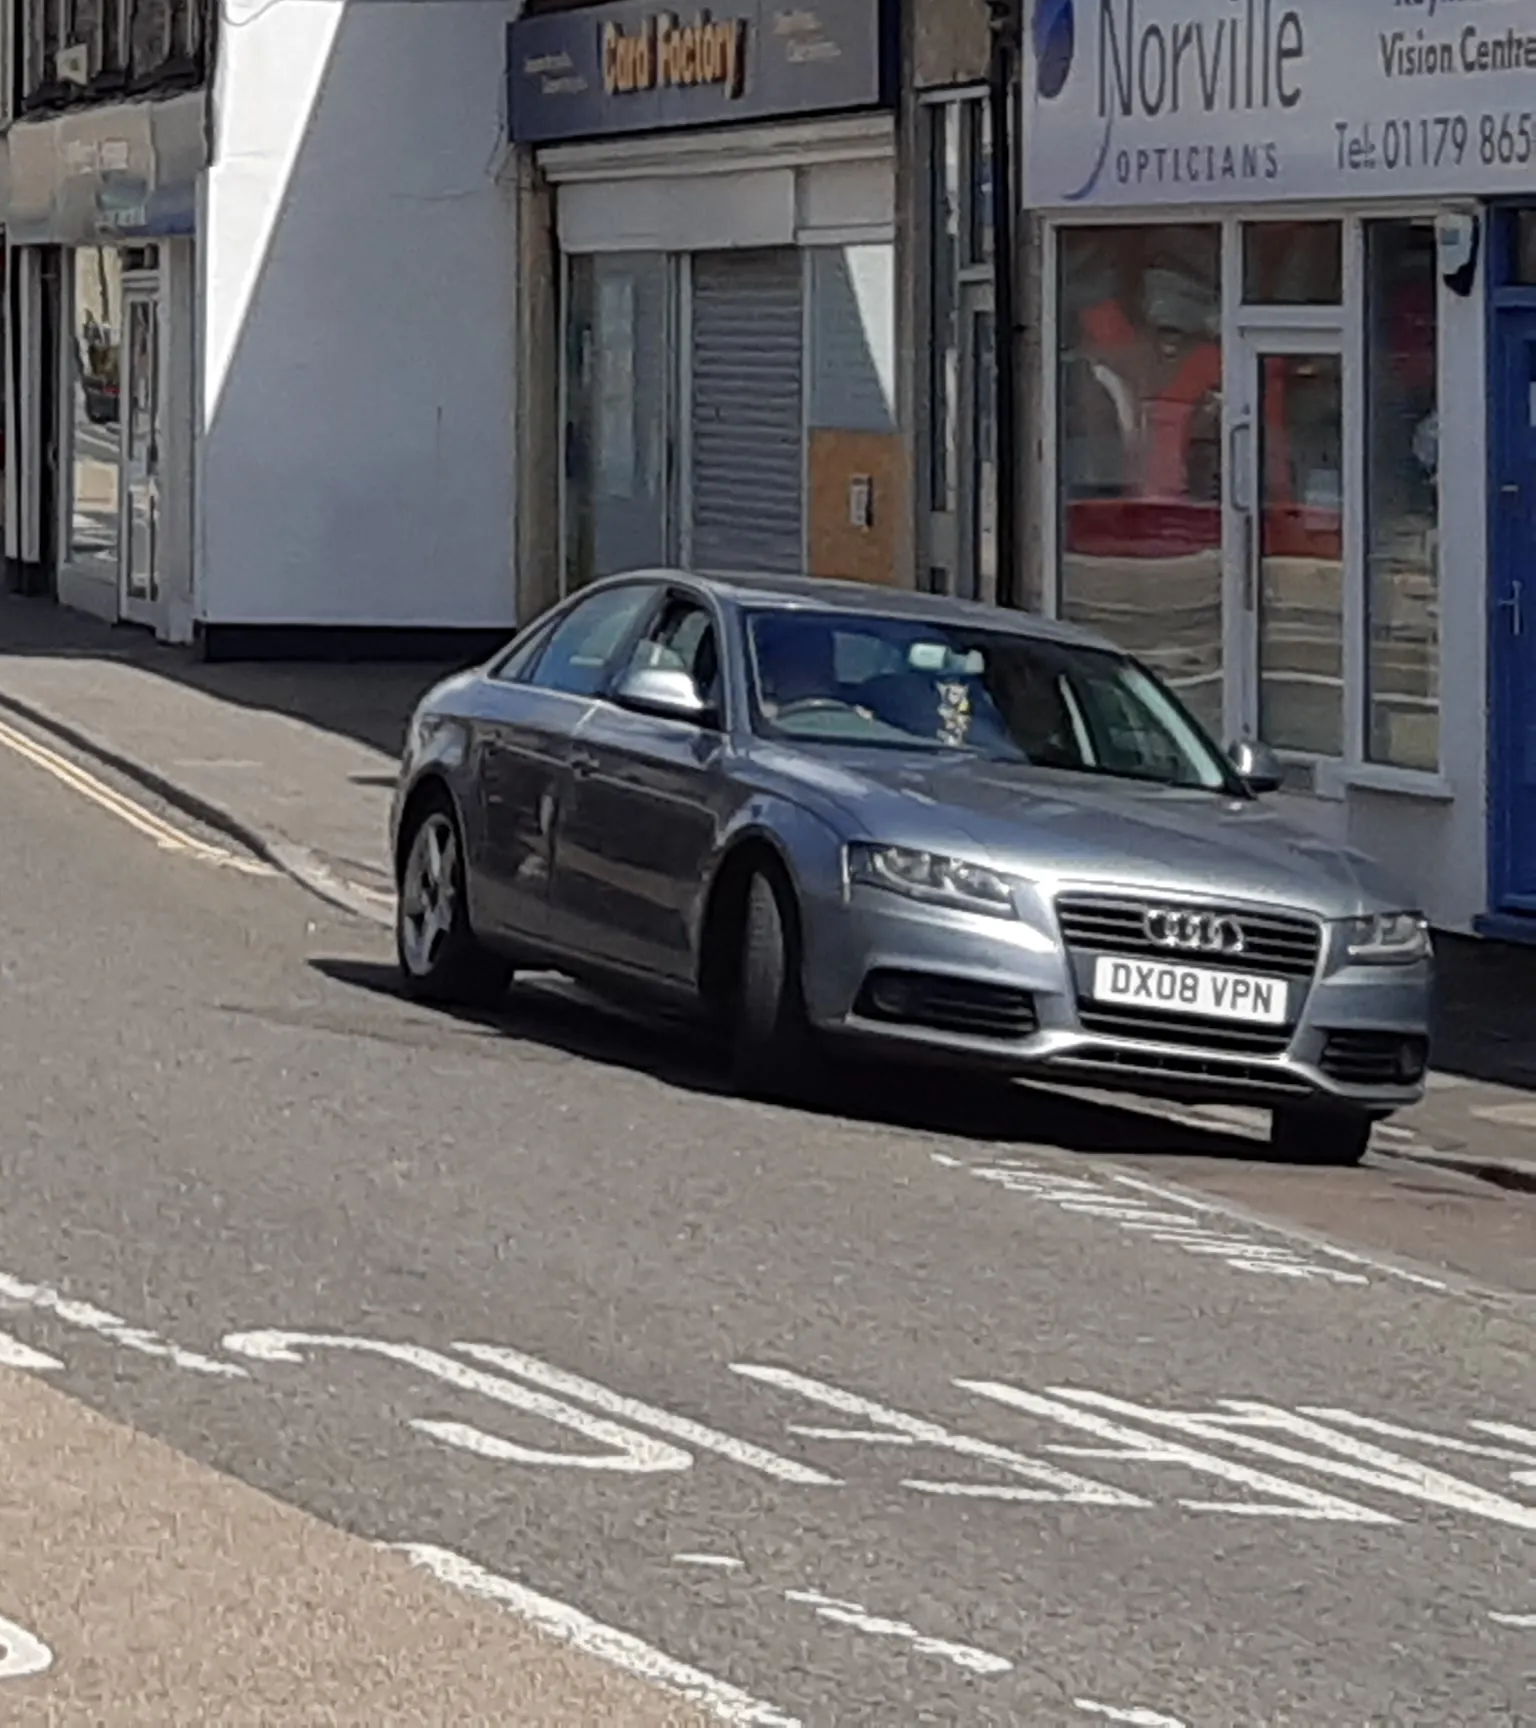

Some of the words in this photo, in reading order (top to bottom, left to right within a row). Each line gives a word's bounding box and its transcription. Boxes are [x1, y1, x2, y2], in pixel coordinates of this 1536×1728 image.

[603, 18, 652, 96] Card
[656, 9, 740, 101] Factory
[1379, 28, 1454, 78] Vision
[1460, 24, 1536, 73] Centre
[1116, 142, 1279, 184] OPTICIANS
[1382, 115, 1469, 170] 01179
[1479, 112, 1536, 165] 865
[1110, 962, 1199, 1005] DX08
[1211, 975, 1274, 1015] VPN
